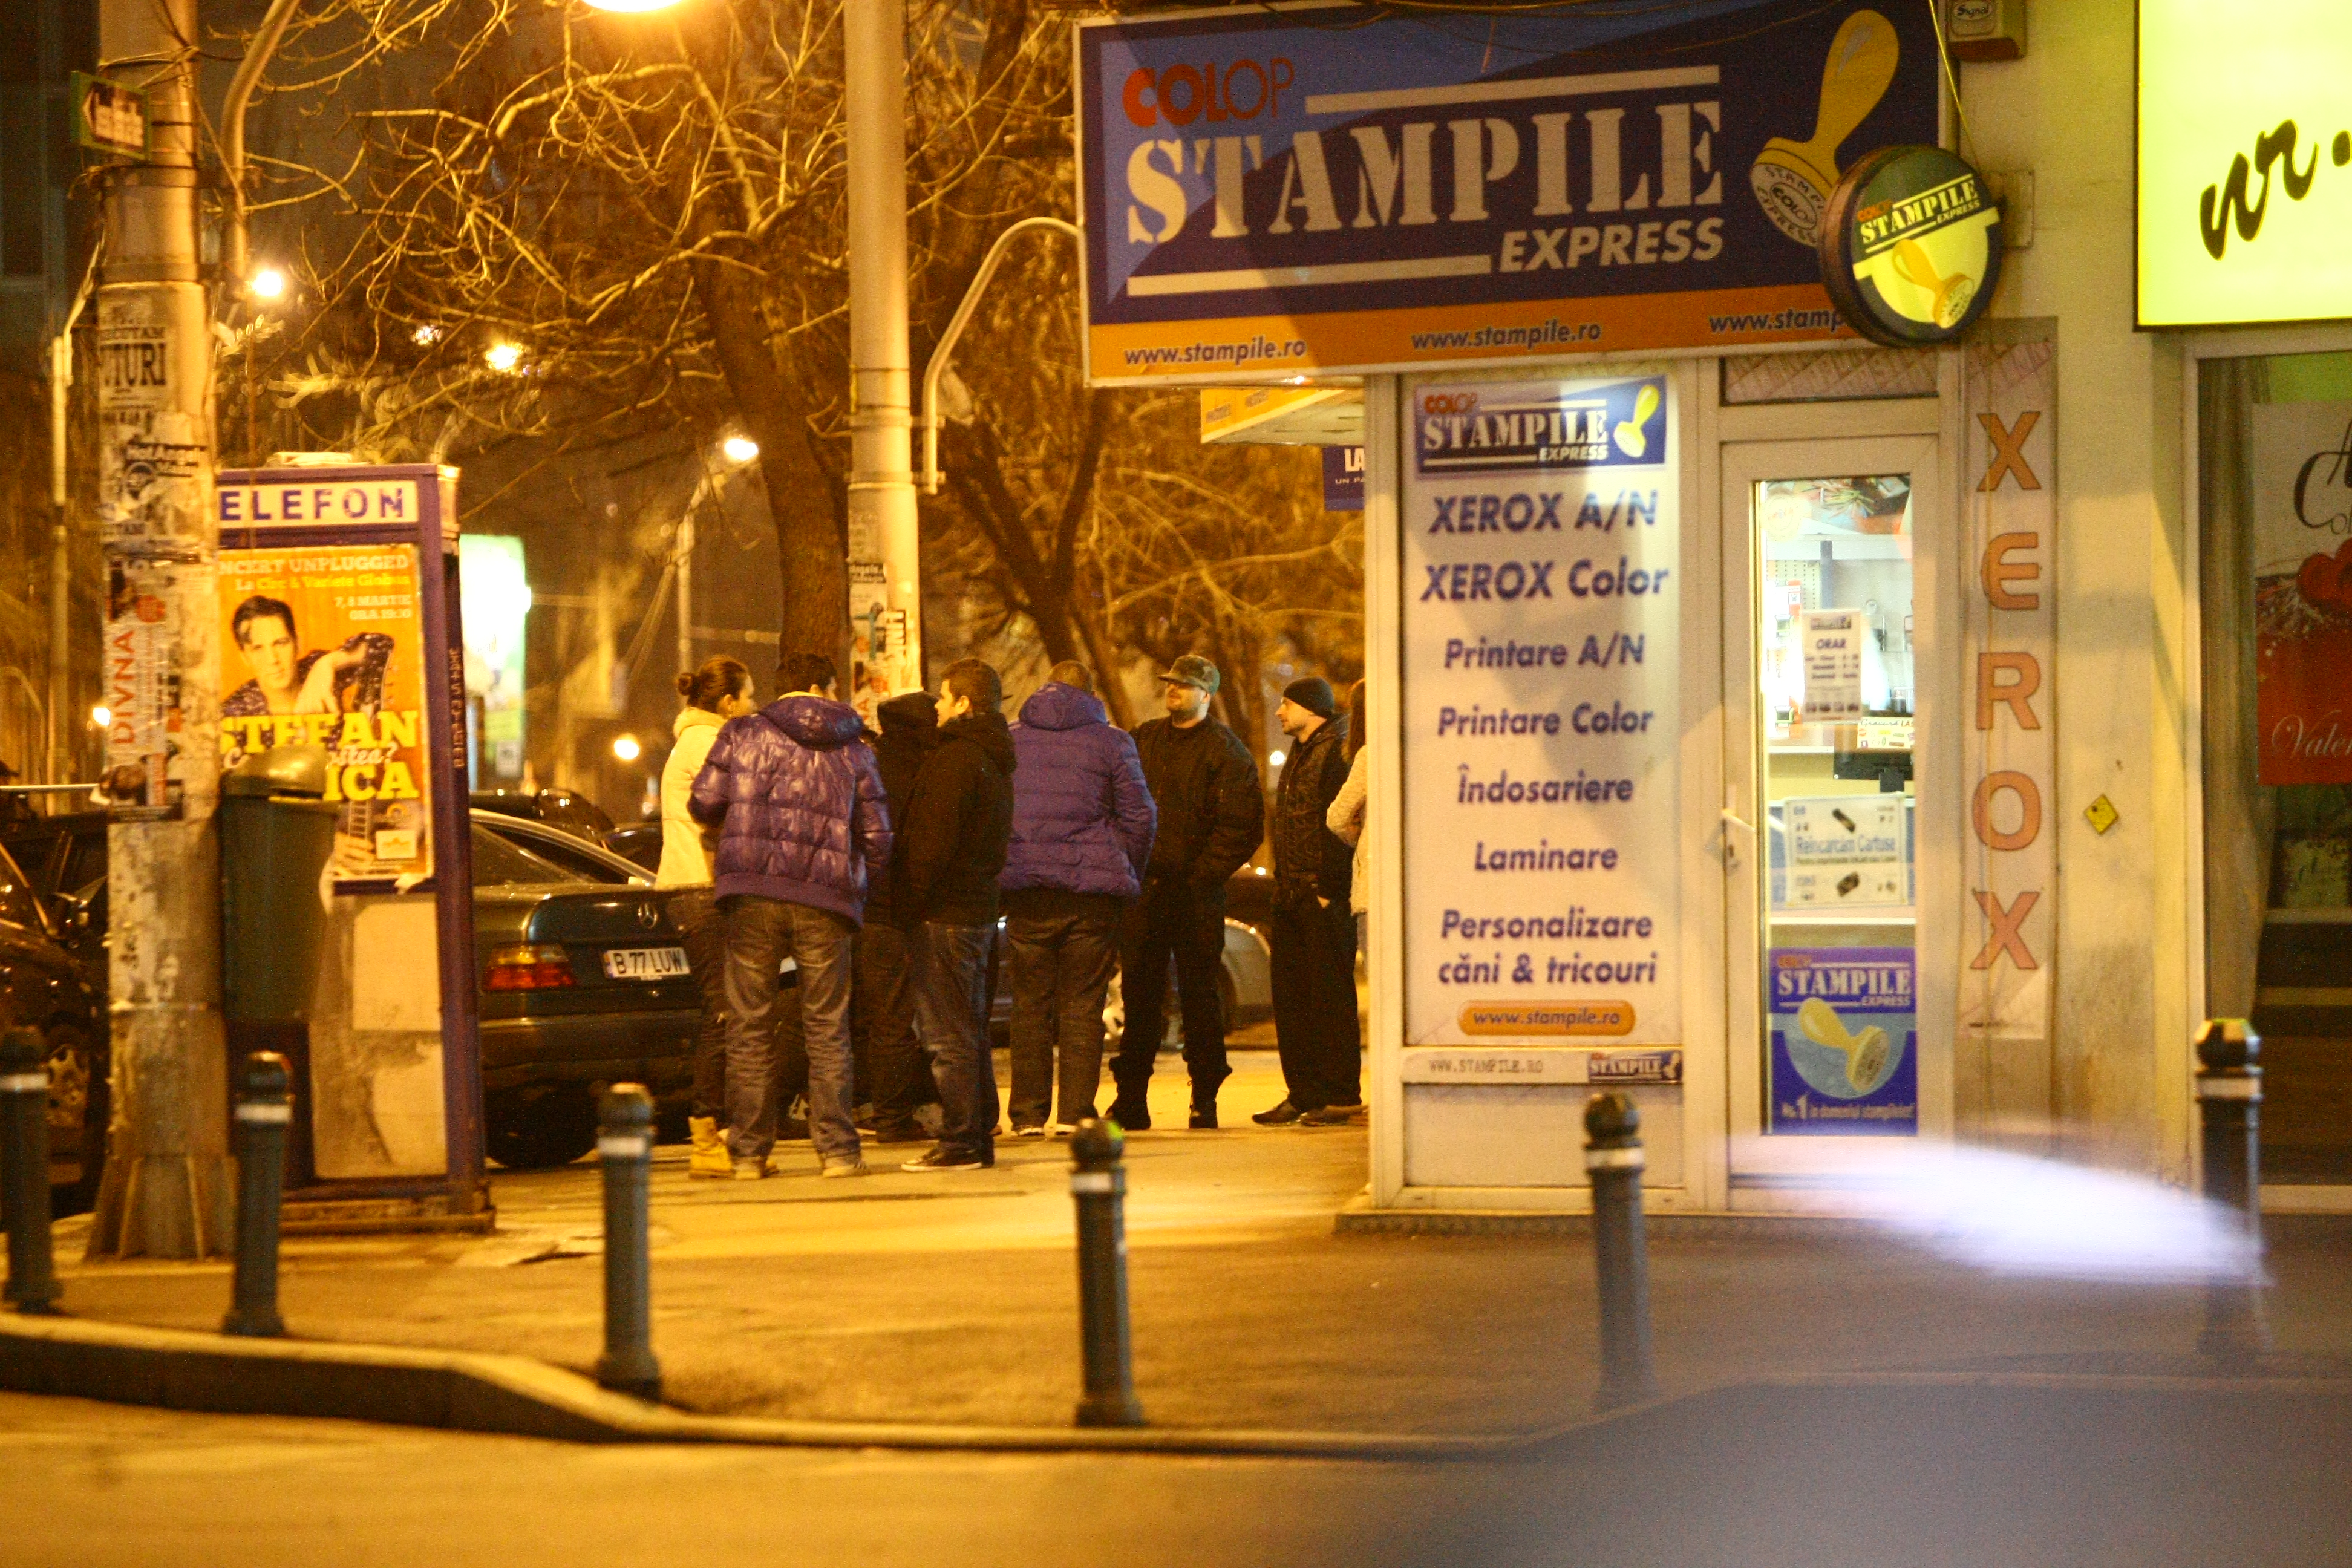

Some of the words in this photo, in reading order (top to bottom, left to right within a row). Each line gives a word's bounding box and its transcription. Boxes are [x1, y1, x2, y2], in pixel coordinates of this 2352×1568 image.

[1122, 58, 1295, 128] COLOP
[1126, 100, 1723, 244] STAMPILE
[1860, 180, 1977, 244] STAMPILE
[1937, 200, 1980, 223] EXPRESS
[1500, 217, 1726, 273] EXPRESS
[1124, 335, 1307, 367] www.stampile.ro
[1411, 318, 1602, 351] www.stampile.ro
[1424, 393, 1478, 413] COLOP
[1423, 410, 1608, 450] STAMPILE
[1538, 445, 1609, 462] EXPRESS
[219, 488, 403, 520] ELEFON
[1428, 492, 1564, 534] XEROX
[1575, 488, 1658, 533] A/N
[287, 553, 410, 573] UNPLUGGED
[1420, 560, 1553, 601] XEROX
[1568, 555, 1670, 597] Color
[235, 578, 255, 591] La
[1444, 635, 1569, 668] Printare
[1578, 631, 1645, 667] A/N
[111, 630, 135, 744] DIVNA
[1968, 411, 2043, 970] XEROX
[1437, 704, 1561, 736] Printare
[1572, 700, 1653, 734] Color
[1457, 763, 1634, 805] Îndosariere
[1474, 840, 1618, 871] Laminare
[1440, 906, 1653, 939] Personalizare
[612, 952, 627, 975] B
[628, 951, 646, 974] 77
[1438, 953, 1501, 984] căni
[1511, 953, 1534, 984] &
[1546, 952, 1659, 984] tricouri
[1778, 969, 1912, 996] STAMPILE
[1472, 1010, 1621, 1030] www.stampile.ro
[1429, 1059, 1544, 1074] WWW.STAMPILE.RO
